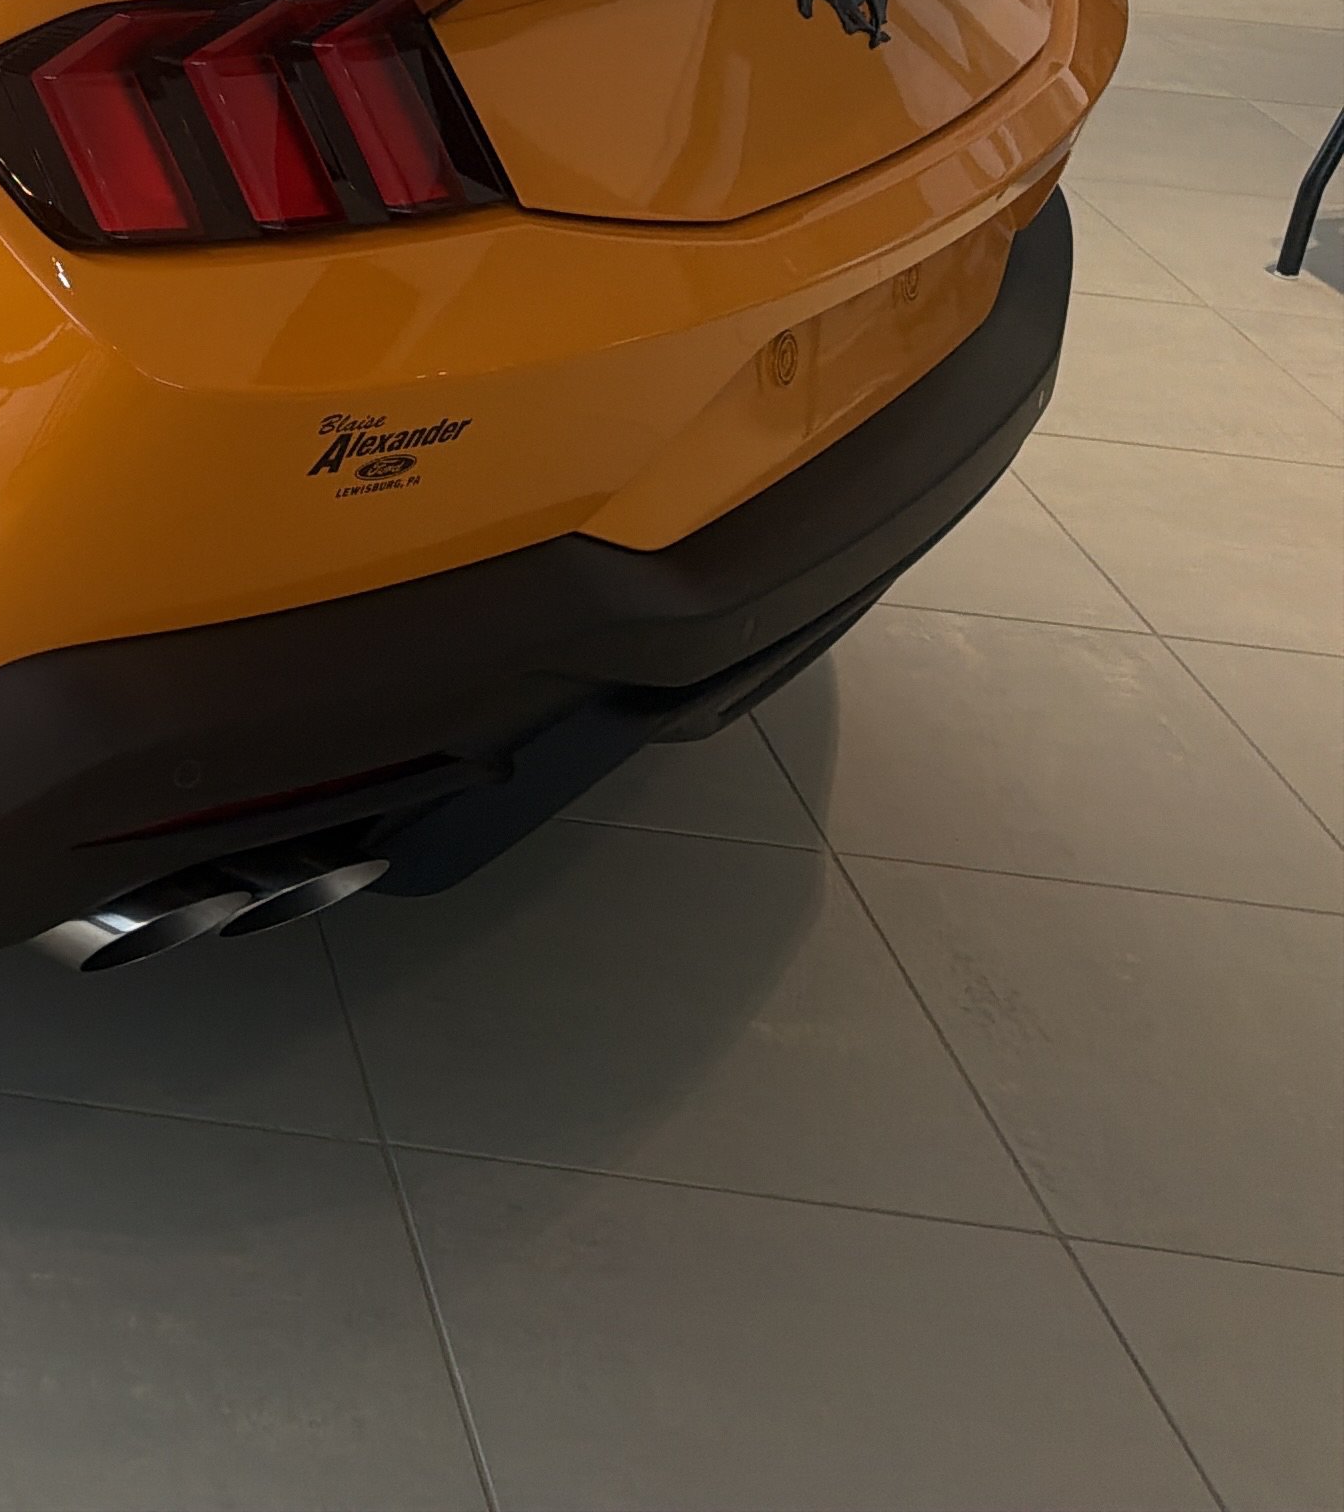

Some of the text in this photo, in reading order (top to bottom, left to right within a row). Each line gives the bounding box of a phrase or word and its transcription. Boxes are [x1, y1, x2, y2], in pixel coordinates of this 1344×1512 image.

[317, 413, 387, 436] Blaise
[306, 417, 473, 477] Alexander
[406, 474, 422, 486] PA
